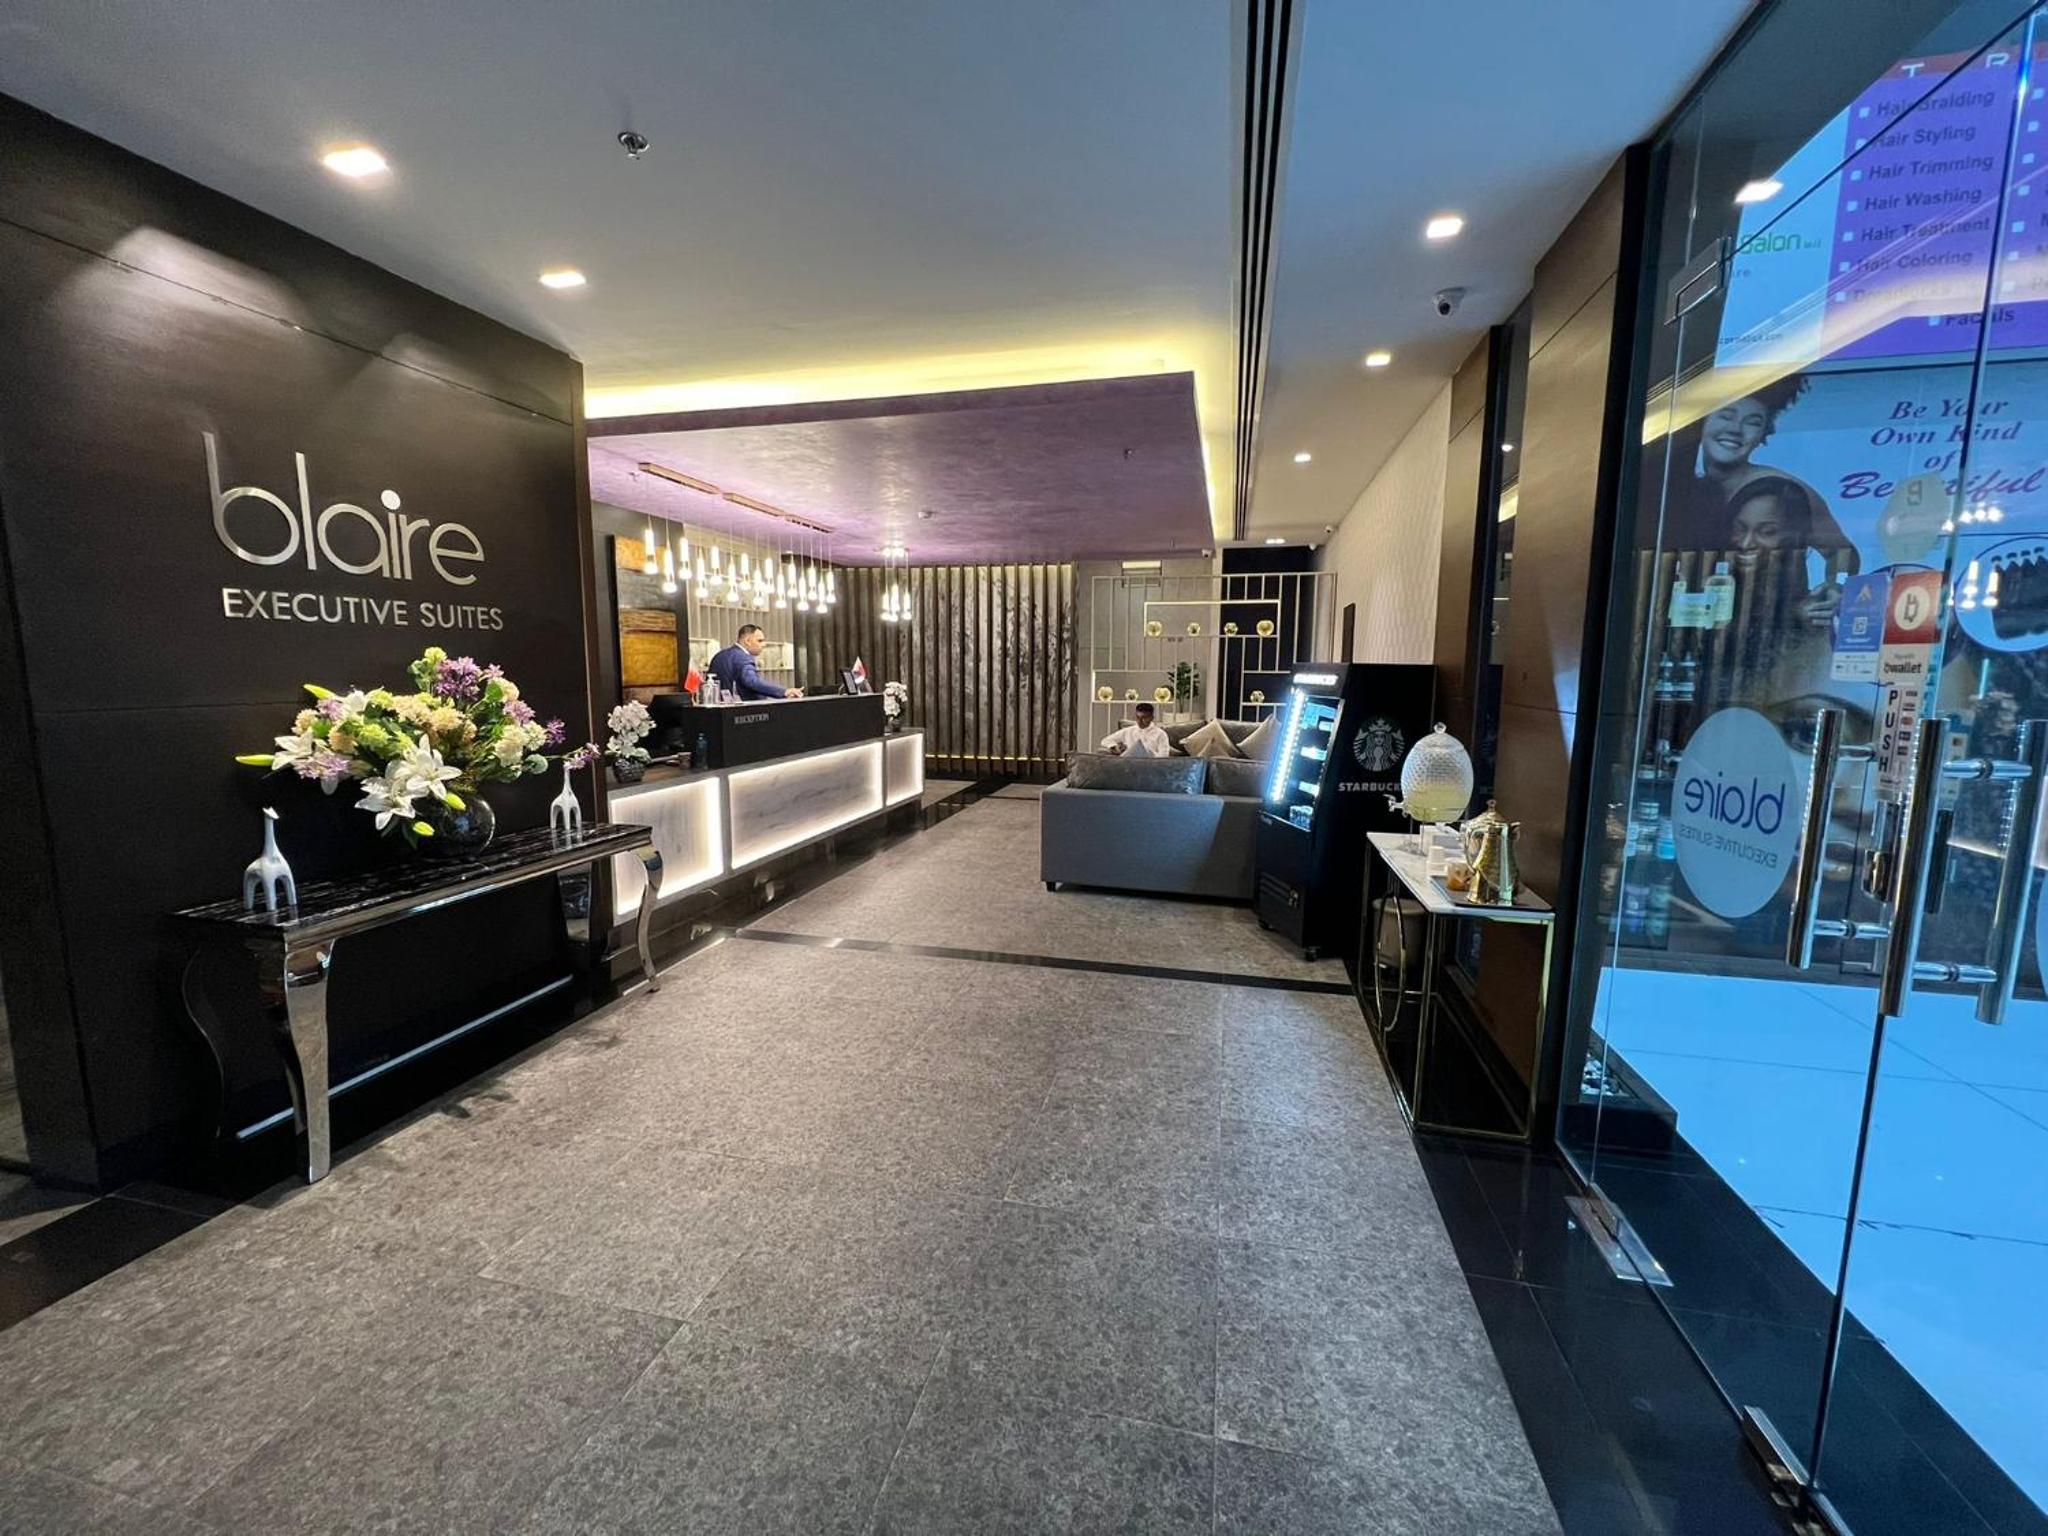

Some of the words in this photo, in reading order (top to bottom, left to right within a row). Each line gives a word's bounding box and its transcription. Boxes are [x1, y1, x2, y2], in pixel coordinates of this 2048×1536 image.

[1919, 90, 1995, 110] Braiding
[1873, 131, 1909, 151] Hair
[1914, 125, 1976, 145] Styling
[1869, 163, 1907, 180] Hair
[1911, 156, 1994, 176] Trimming
[1864, 195, 1900, 211] Hair
[1905, 188, 1982, 207] Washing
[1861, 228, 1895, 242] Hair
[1903, 217, 1990, 238] Treatment
[1897, 250, 1974, 269] Coloring
[1889, 400, 1927, 420] Be
[1870, 426, 1936, 446] Own
[1924, 451, 1957, 473] of
[203, 431, 485, 586] blaire
[221, 588, 409, 627] EXECUTIVE
[419, 602, 504, 631] SUITES
[1878, 689, 1899, 773] PUSH
